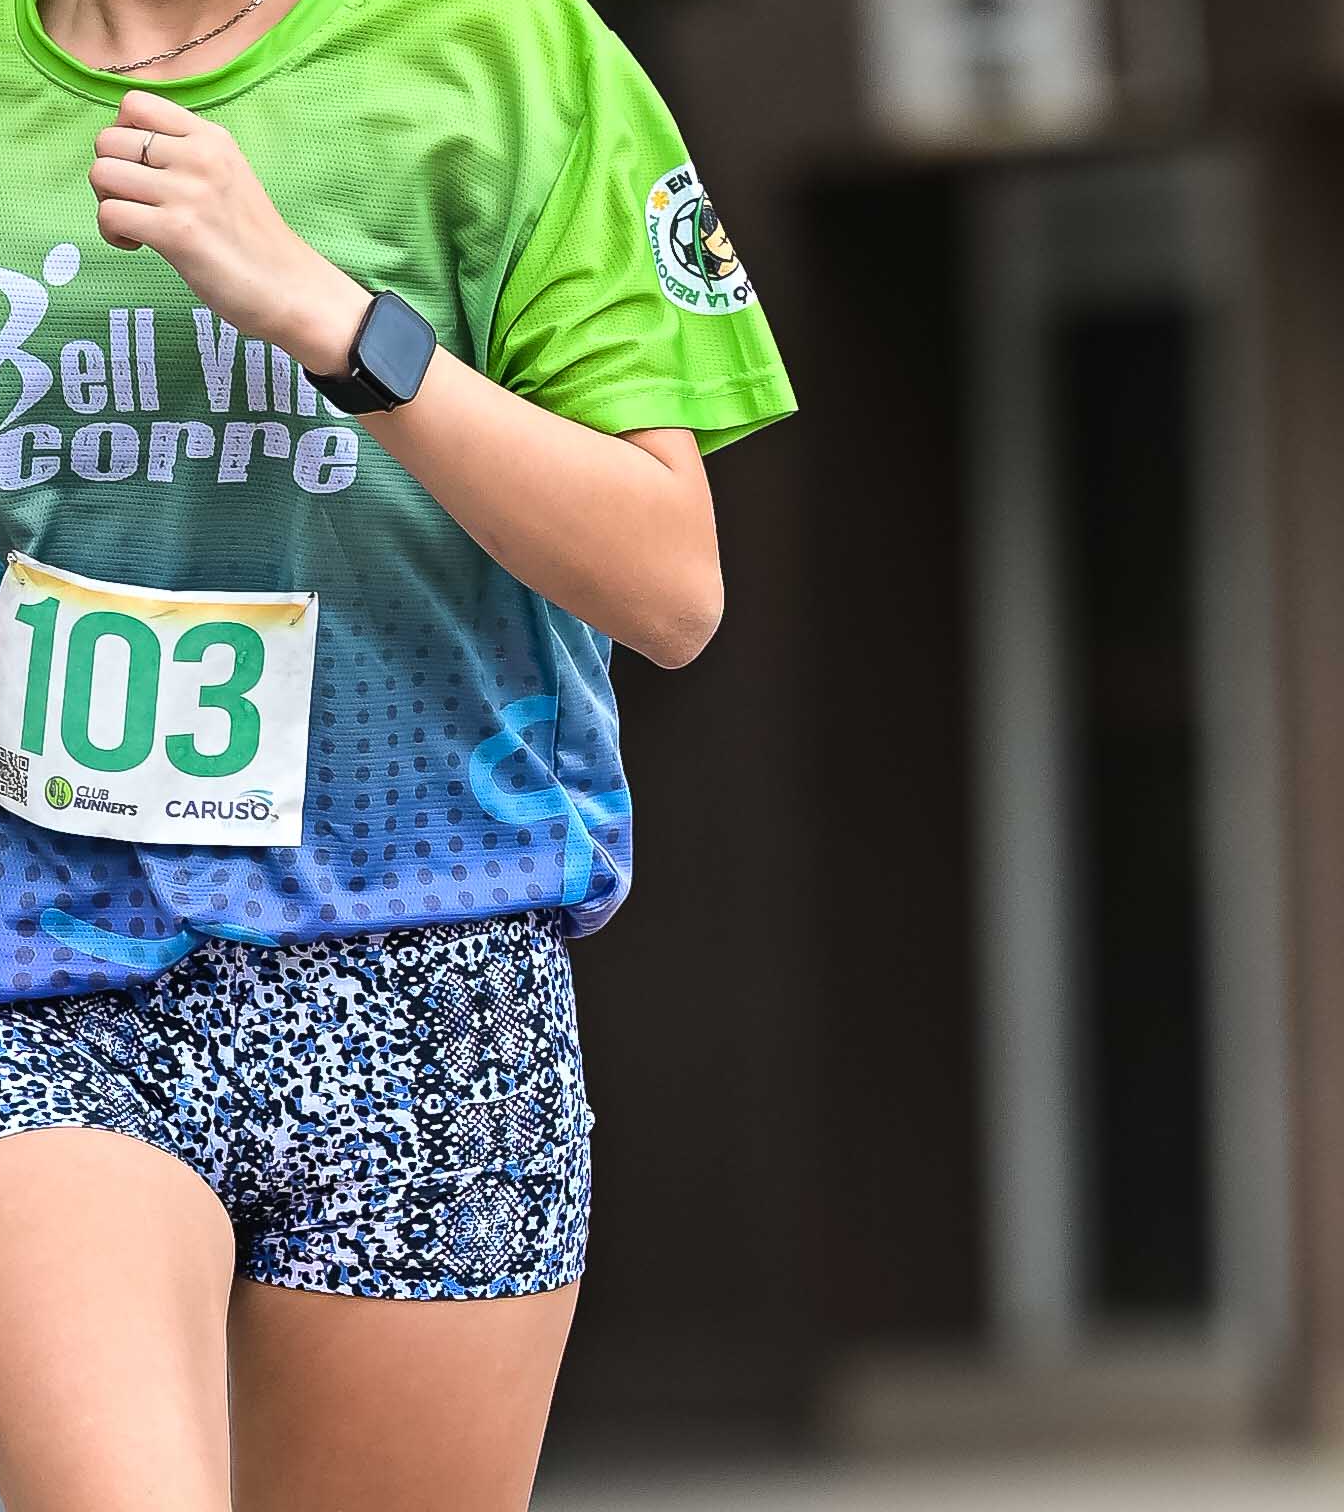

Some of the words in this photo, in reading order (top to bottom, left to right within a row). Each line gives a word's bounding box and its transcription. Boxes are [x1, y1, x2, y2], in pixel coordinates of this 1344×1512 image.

[665, 170, 693, 195] EN
[706, 293, 730, 307] LA
[14, 596, 266, 778] 103
[76, 786, 110, 801] CLUB
[165, 800, 270, 821] CARUSO
